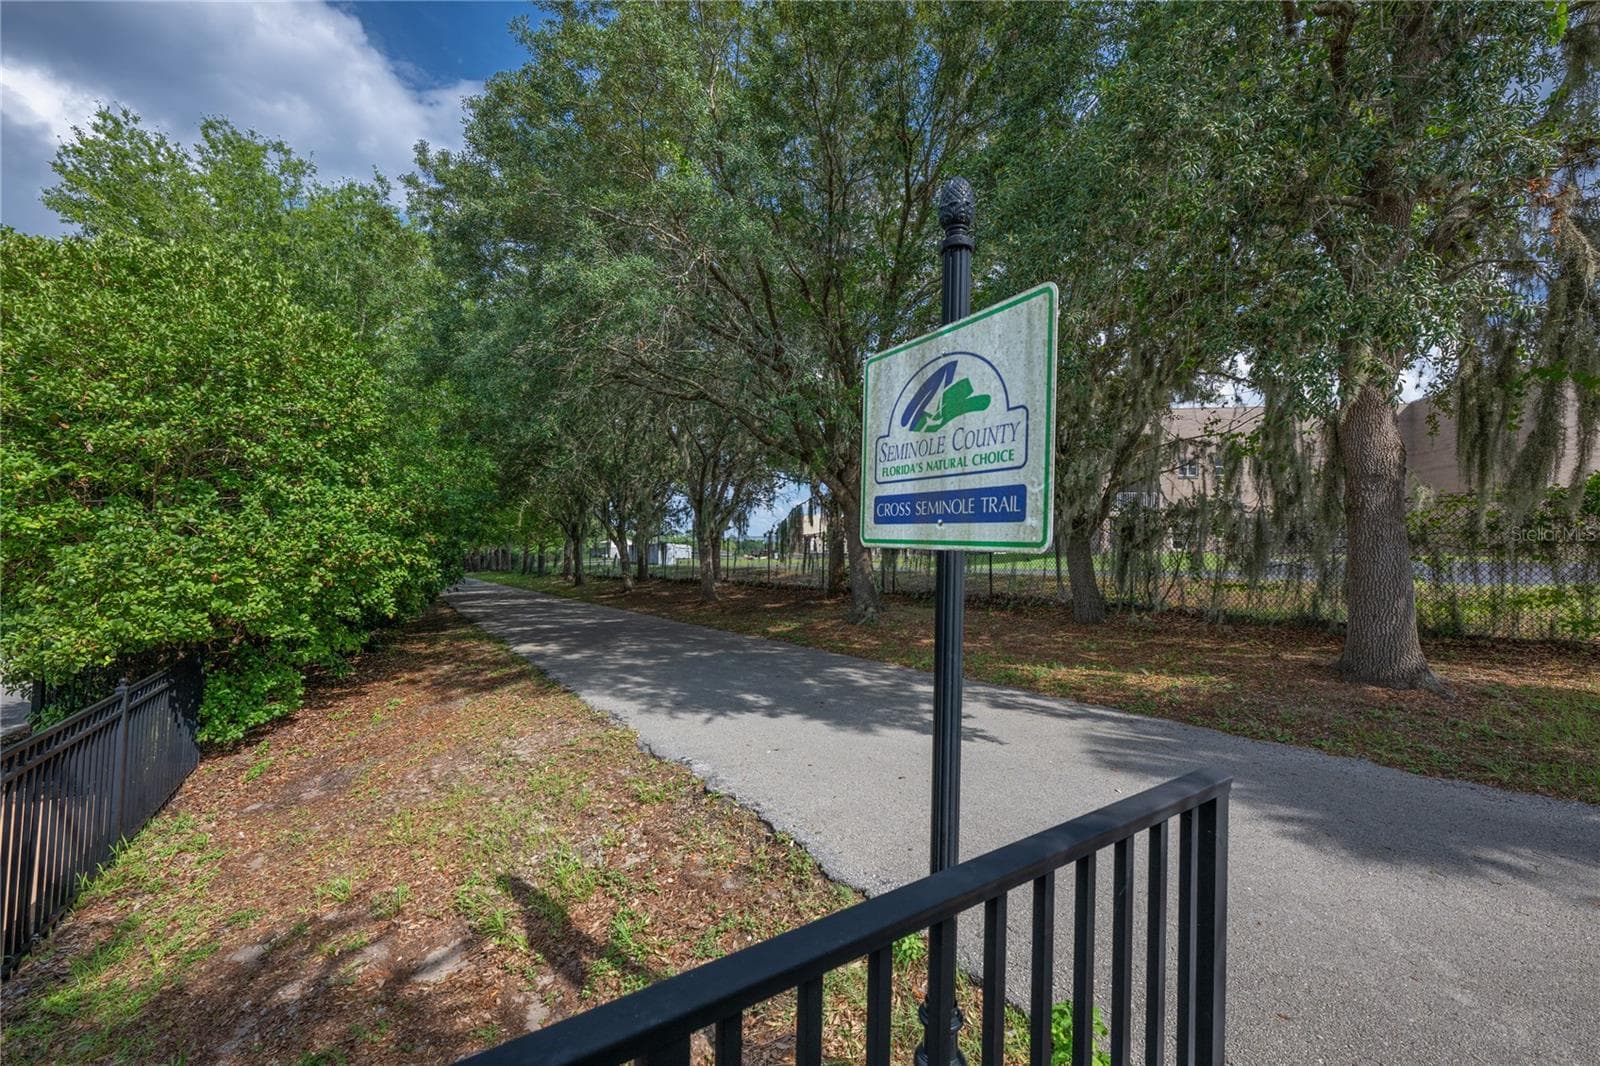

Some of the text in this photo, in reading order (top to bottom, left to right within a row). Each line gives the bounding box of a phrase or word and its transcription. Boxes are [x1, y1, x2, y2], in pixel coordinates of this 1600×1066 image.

[878, 421, 1021, 463] SEMINOLE COUNTY
[881, 449, 1015, 477] FLORIDA'S NATURAL CHOICE
[876, 495, 1021, 517] CROSS SEMINOLE TRAIL
